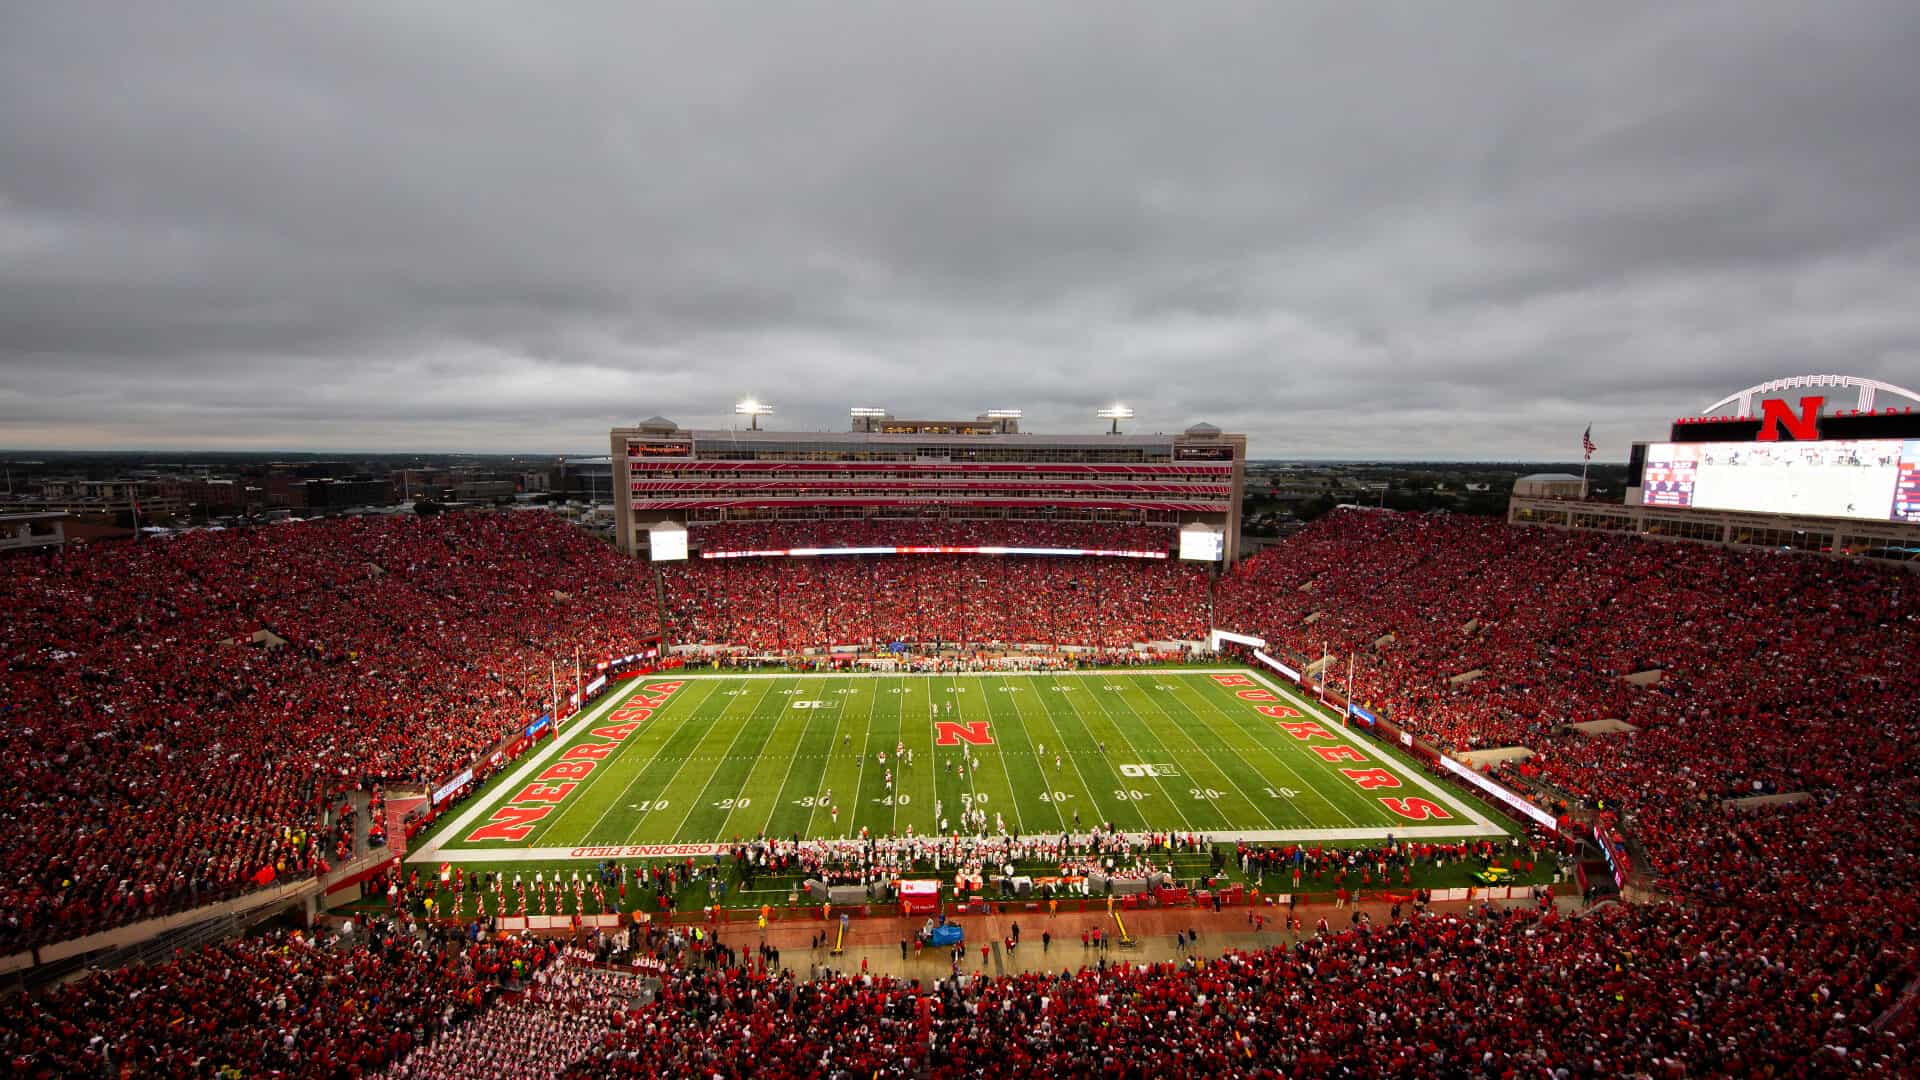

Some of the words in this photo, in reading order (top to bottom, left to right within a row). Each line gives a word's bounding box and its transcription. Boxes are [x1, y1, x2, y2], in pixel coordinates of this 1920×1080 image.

[1757, 397, 1824, 441] N
[935, 720, 995, 746] N
[1212, 674, 1454, 820] HUSKERS
[465, 681, 685, 842] NEBRASKA
[571, 847, 624, 857] FIELD
[626, 844, 712, 856] OSBORNE
